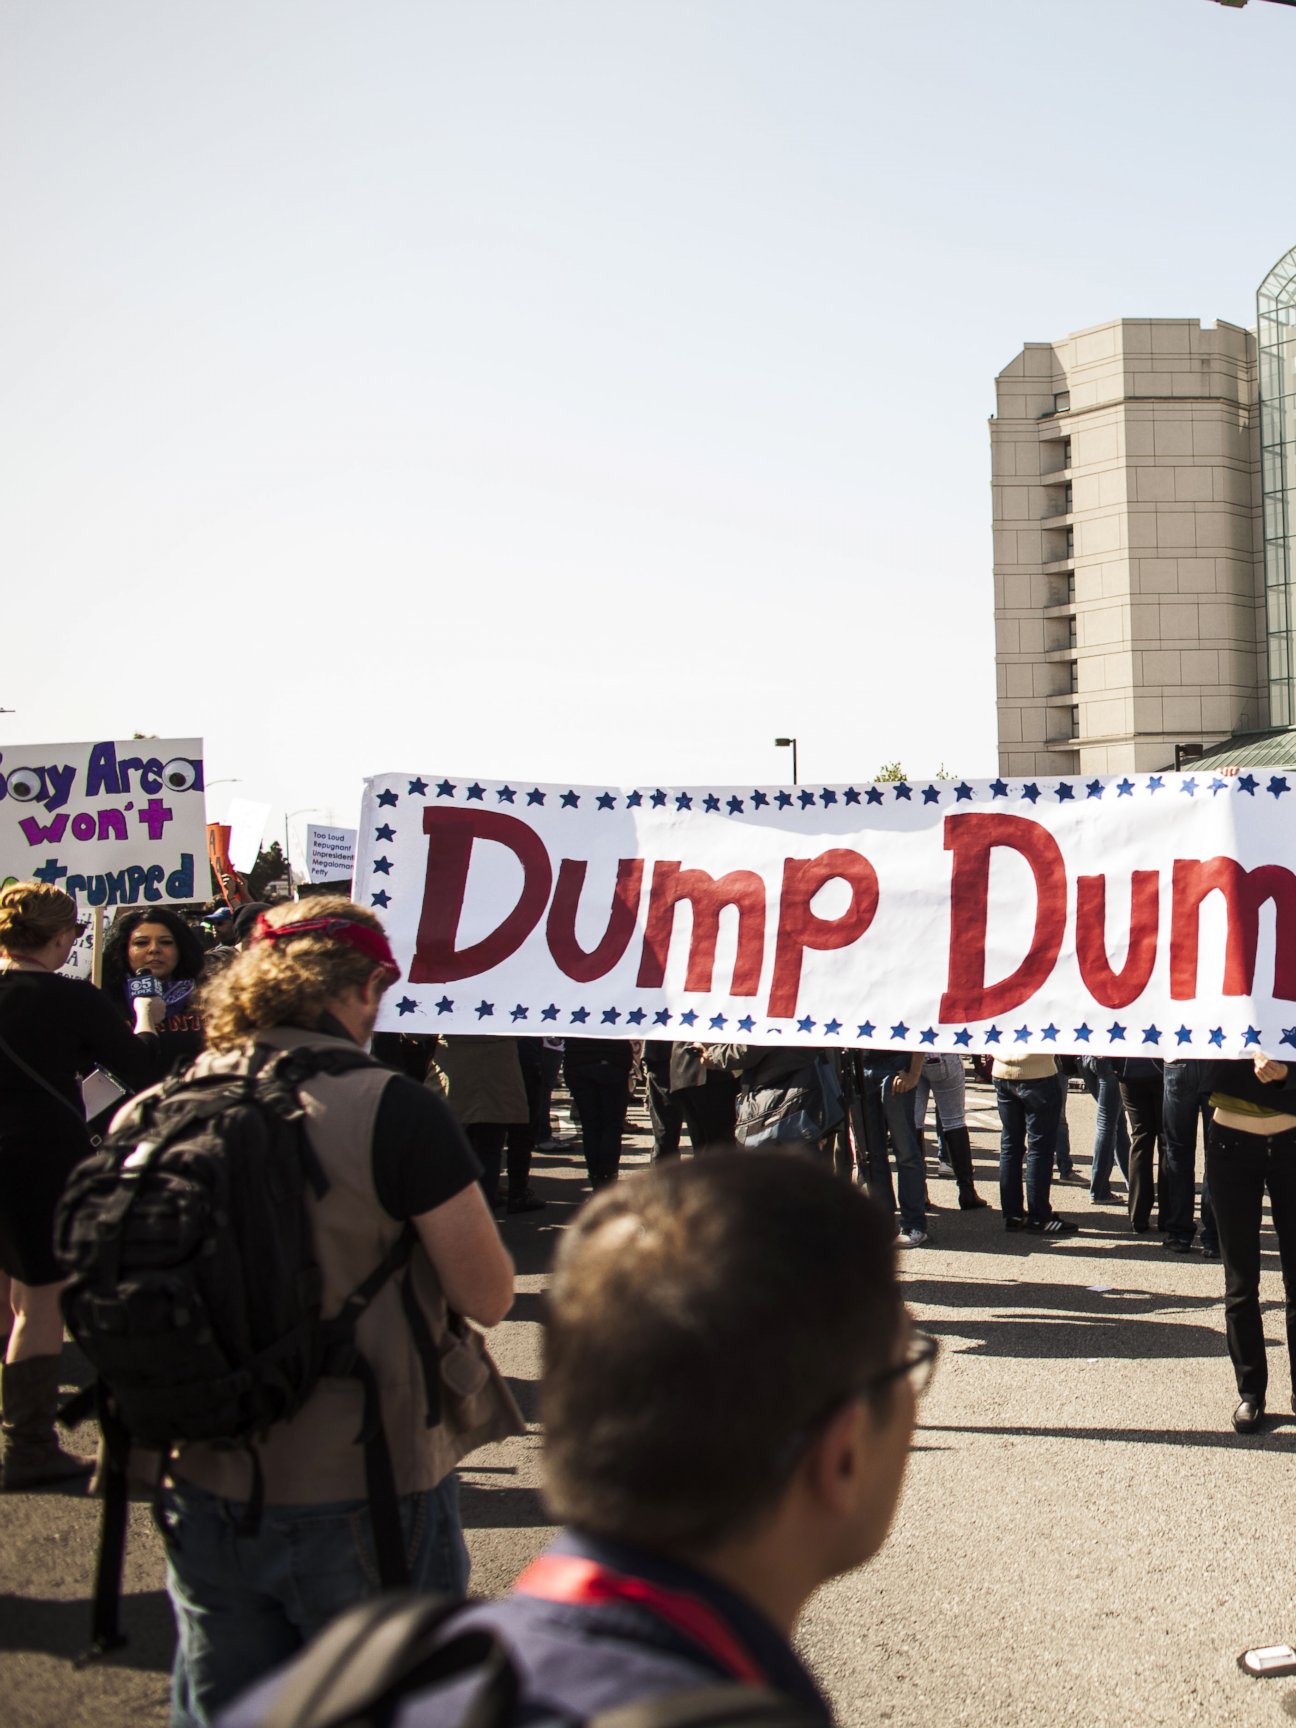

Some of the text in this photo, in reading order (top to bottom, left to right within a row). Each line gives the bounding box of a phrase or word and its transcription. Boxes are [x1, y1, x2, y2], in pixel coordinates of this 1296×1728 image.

[85, 741, 204, 796] Area
[18, 798, 173, 846] won't
[313, 831, 345, 842] Too Loud
[313, 841, 352, 852] Repugnant
[311, 867, 329, 877] Petty
[408, 806, 880, 1019] Dump
[141, 977, 152, 988] 5
